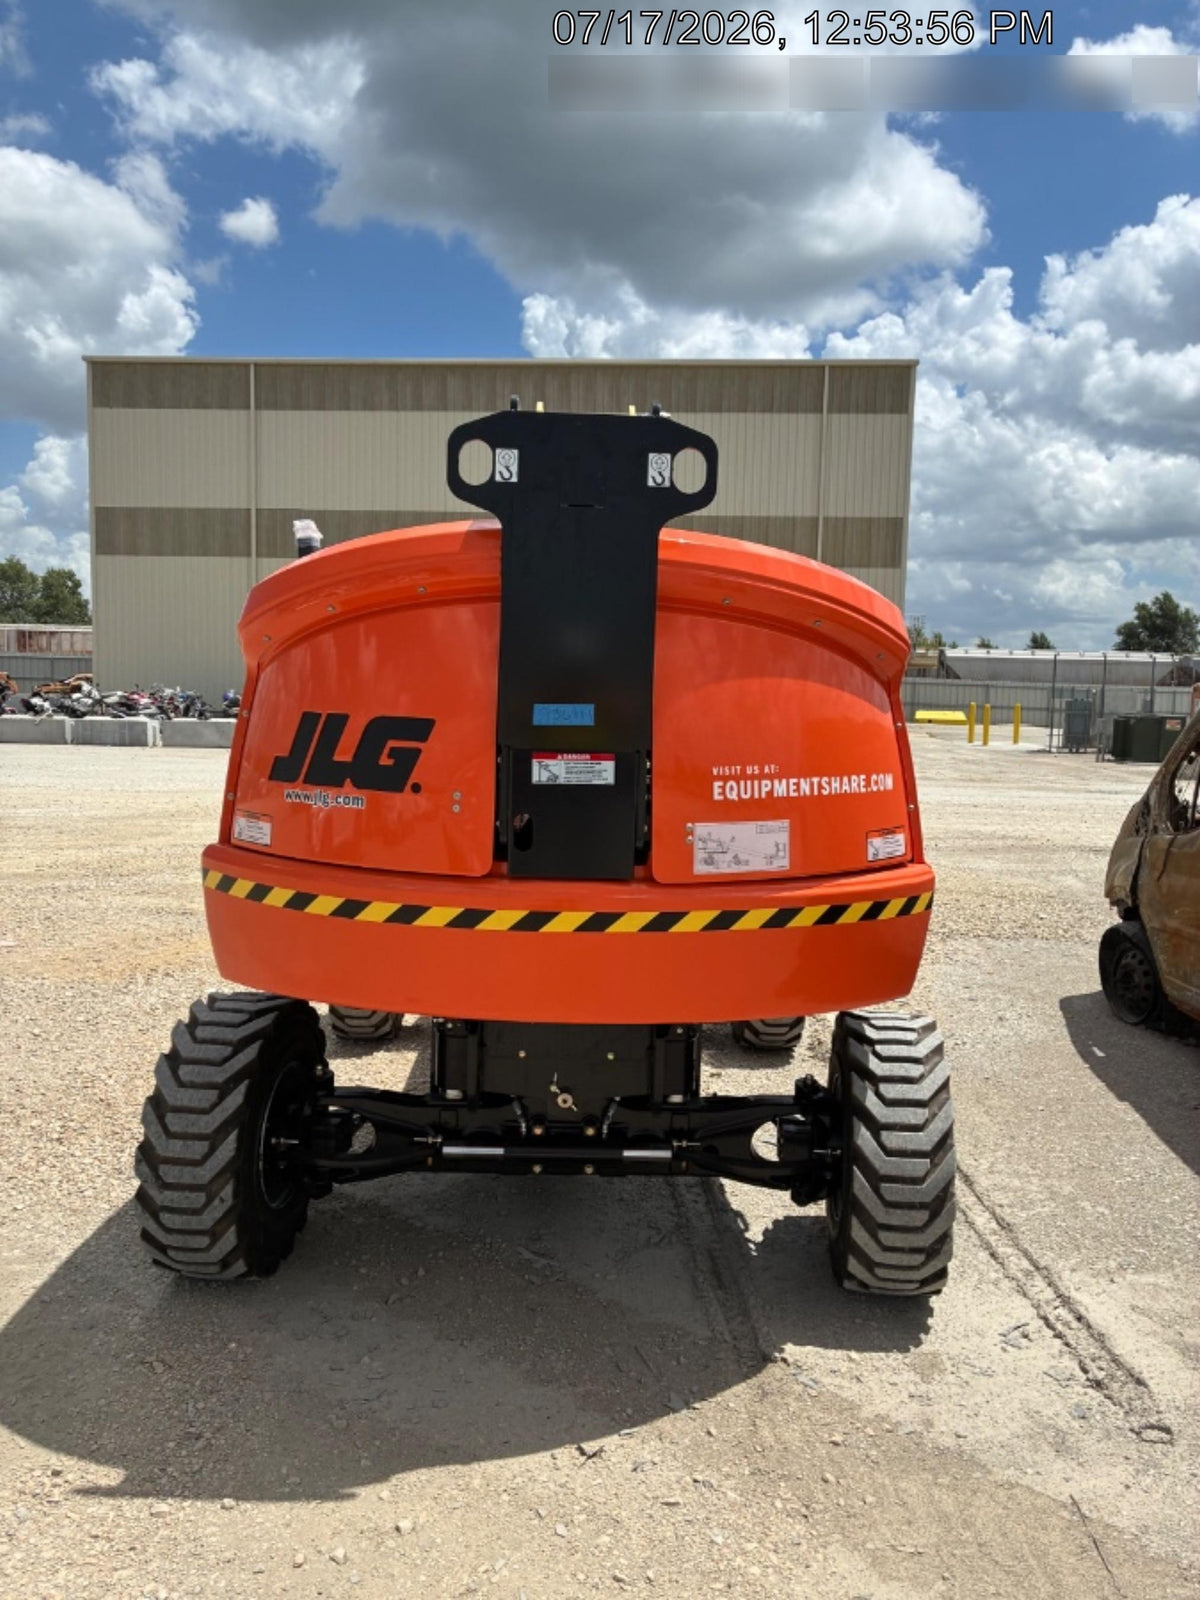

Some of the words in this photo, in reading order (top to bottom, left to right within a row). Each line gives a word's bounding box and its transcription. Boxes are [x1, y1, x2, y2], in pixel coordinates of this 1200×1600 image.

[712, 766, 741, 776] VISIT
[746, 765, 760, 775] US
[764, 764, 780, 774] AT:
[712, 773, 894, 800] EQUIPMENTSHARE.COM
[285, 789, 365, 809] www.jlg.com
